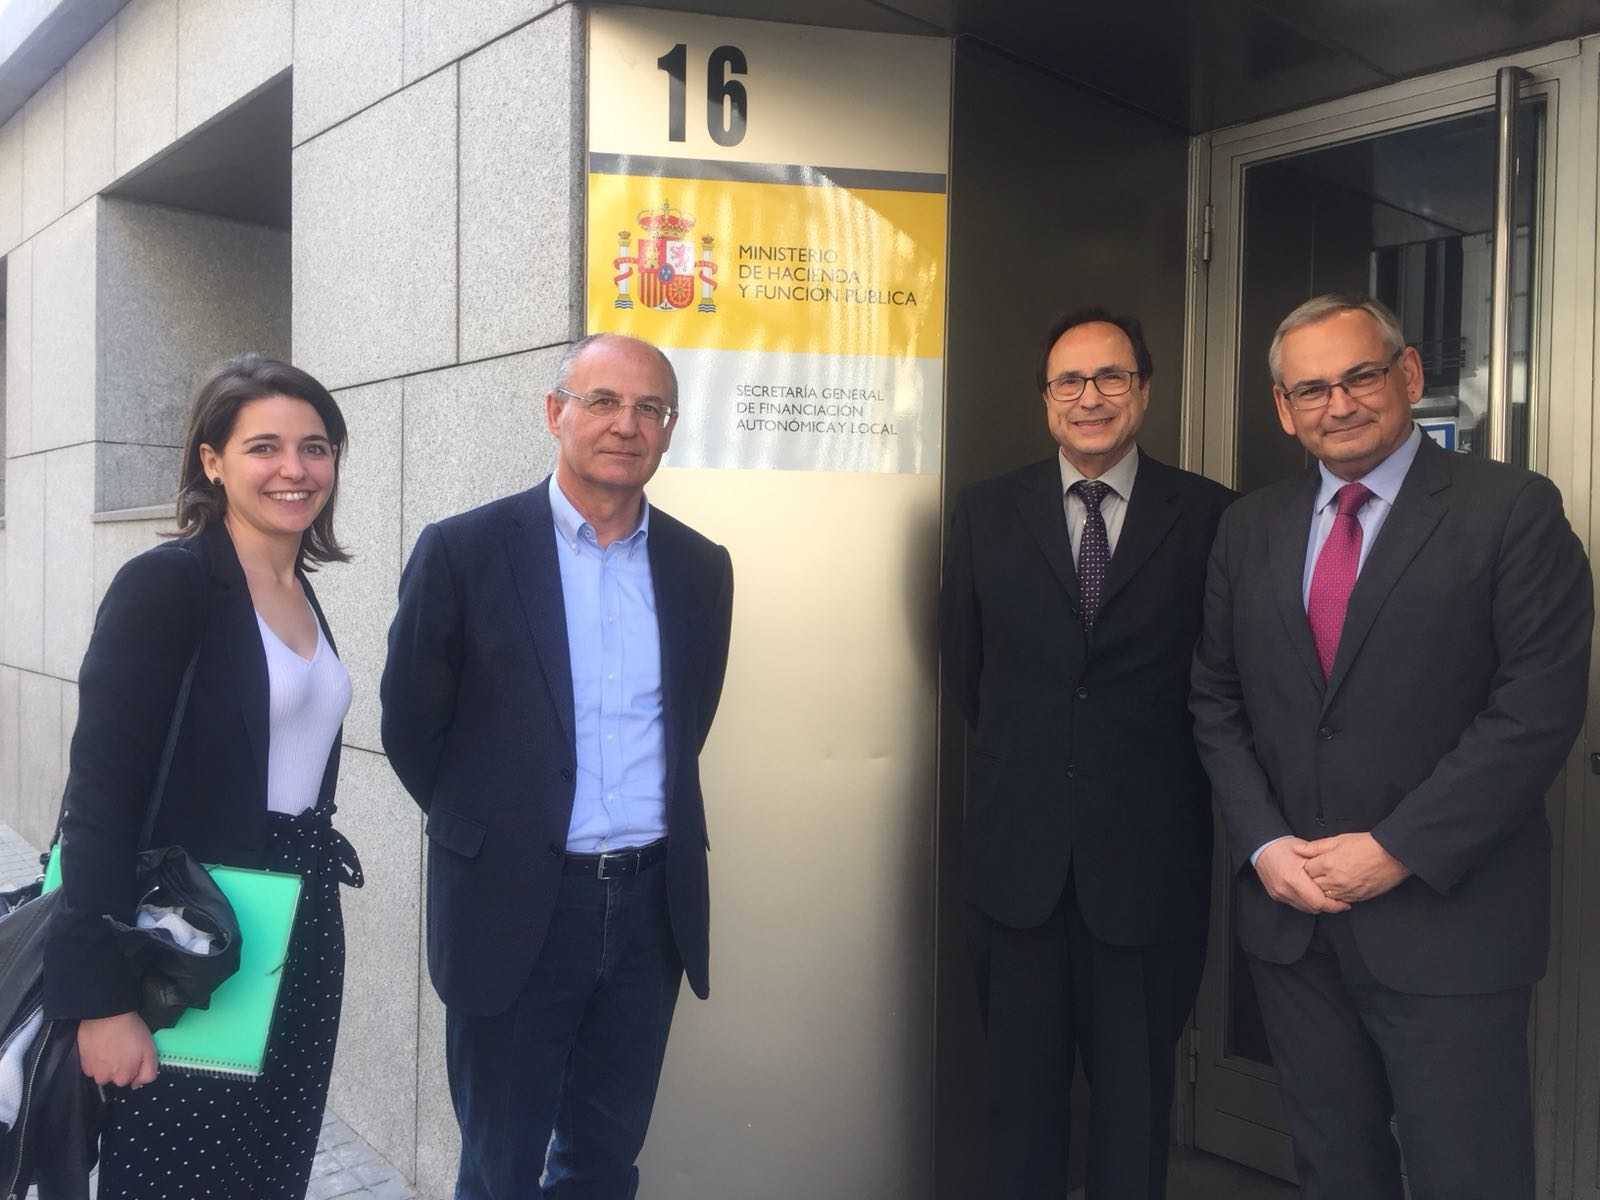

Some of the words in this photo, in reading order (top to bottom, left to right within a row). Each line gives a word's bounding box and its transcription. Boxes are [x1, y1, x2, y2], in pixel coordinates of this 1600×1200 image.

[657, 43, 748, 147] 16
[739, 245, 838, 264] MINISTERIO
[739, 264, 762, 280] DE
[768, 266, 861, 284] HACIENDA
[739, 284, 752, 299] Y
[736, 384, 817, 399] SECRETARÍA
[822, 387, 884, 401] GENERAL
[736, 402, 756, 414] DE
[736, 417, 836, 433] AUTONÓMICA
[838, 421, 847, 433] Y
[851, 422, 898, 435] LOCAL
